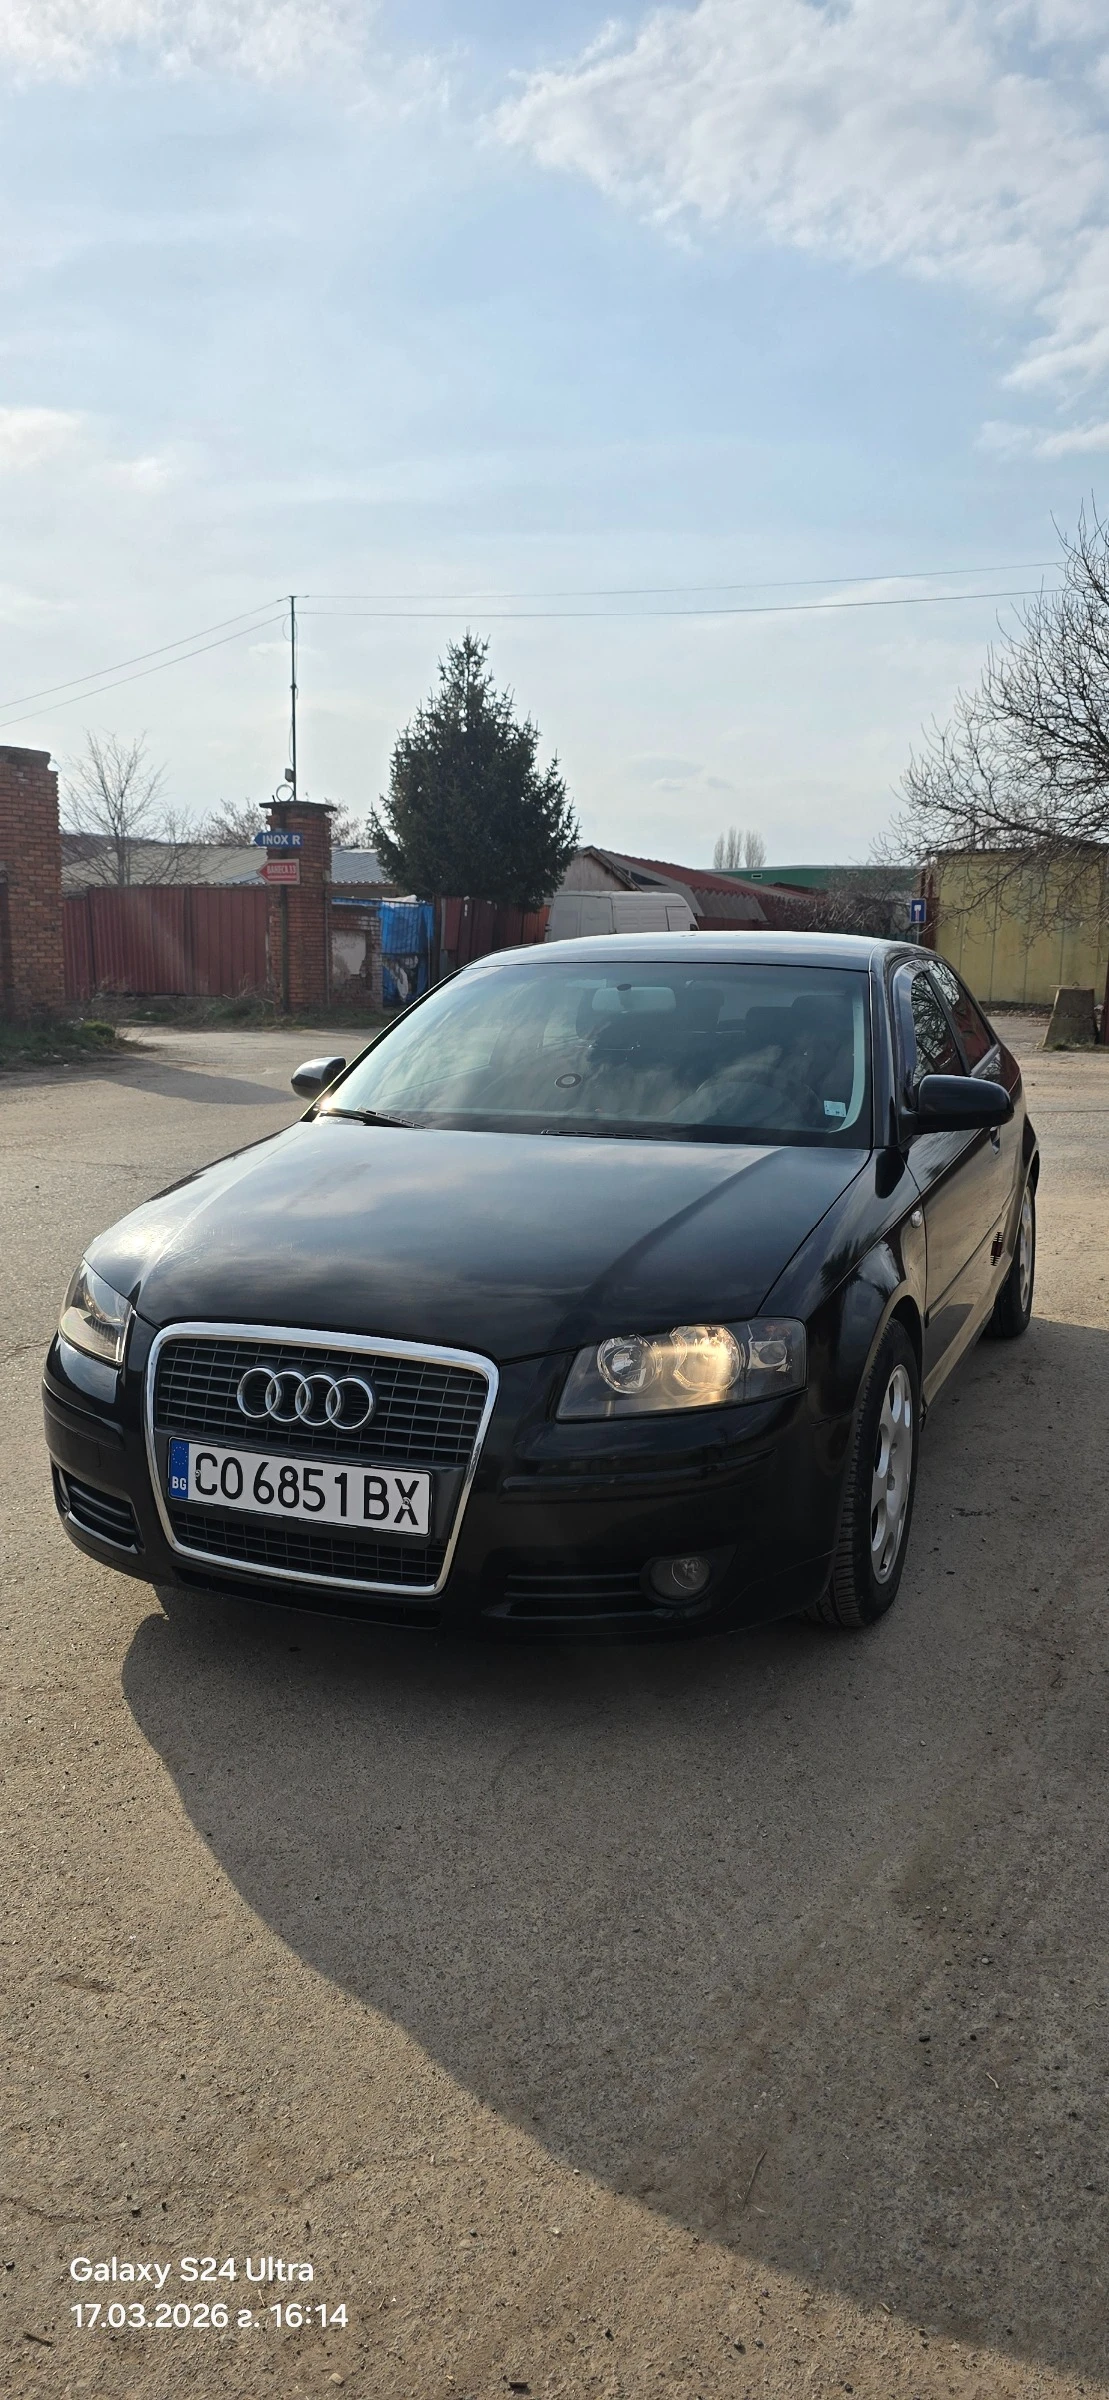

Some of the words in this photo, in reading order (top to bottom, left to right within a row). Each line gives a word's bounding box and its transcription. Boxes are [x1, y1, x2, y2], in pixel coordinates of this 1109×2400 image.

[262, 835, 289, 845] INOX
[292, 835, 301, 845] R
[171, 1475, 188, 1491] BG
[194, 1451, 244, 1501] CO
[252, 1461, 348, 1518] 6851
[363, 1474, 420, 1526] BX
